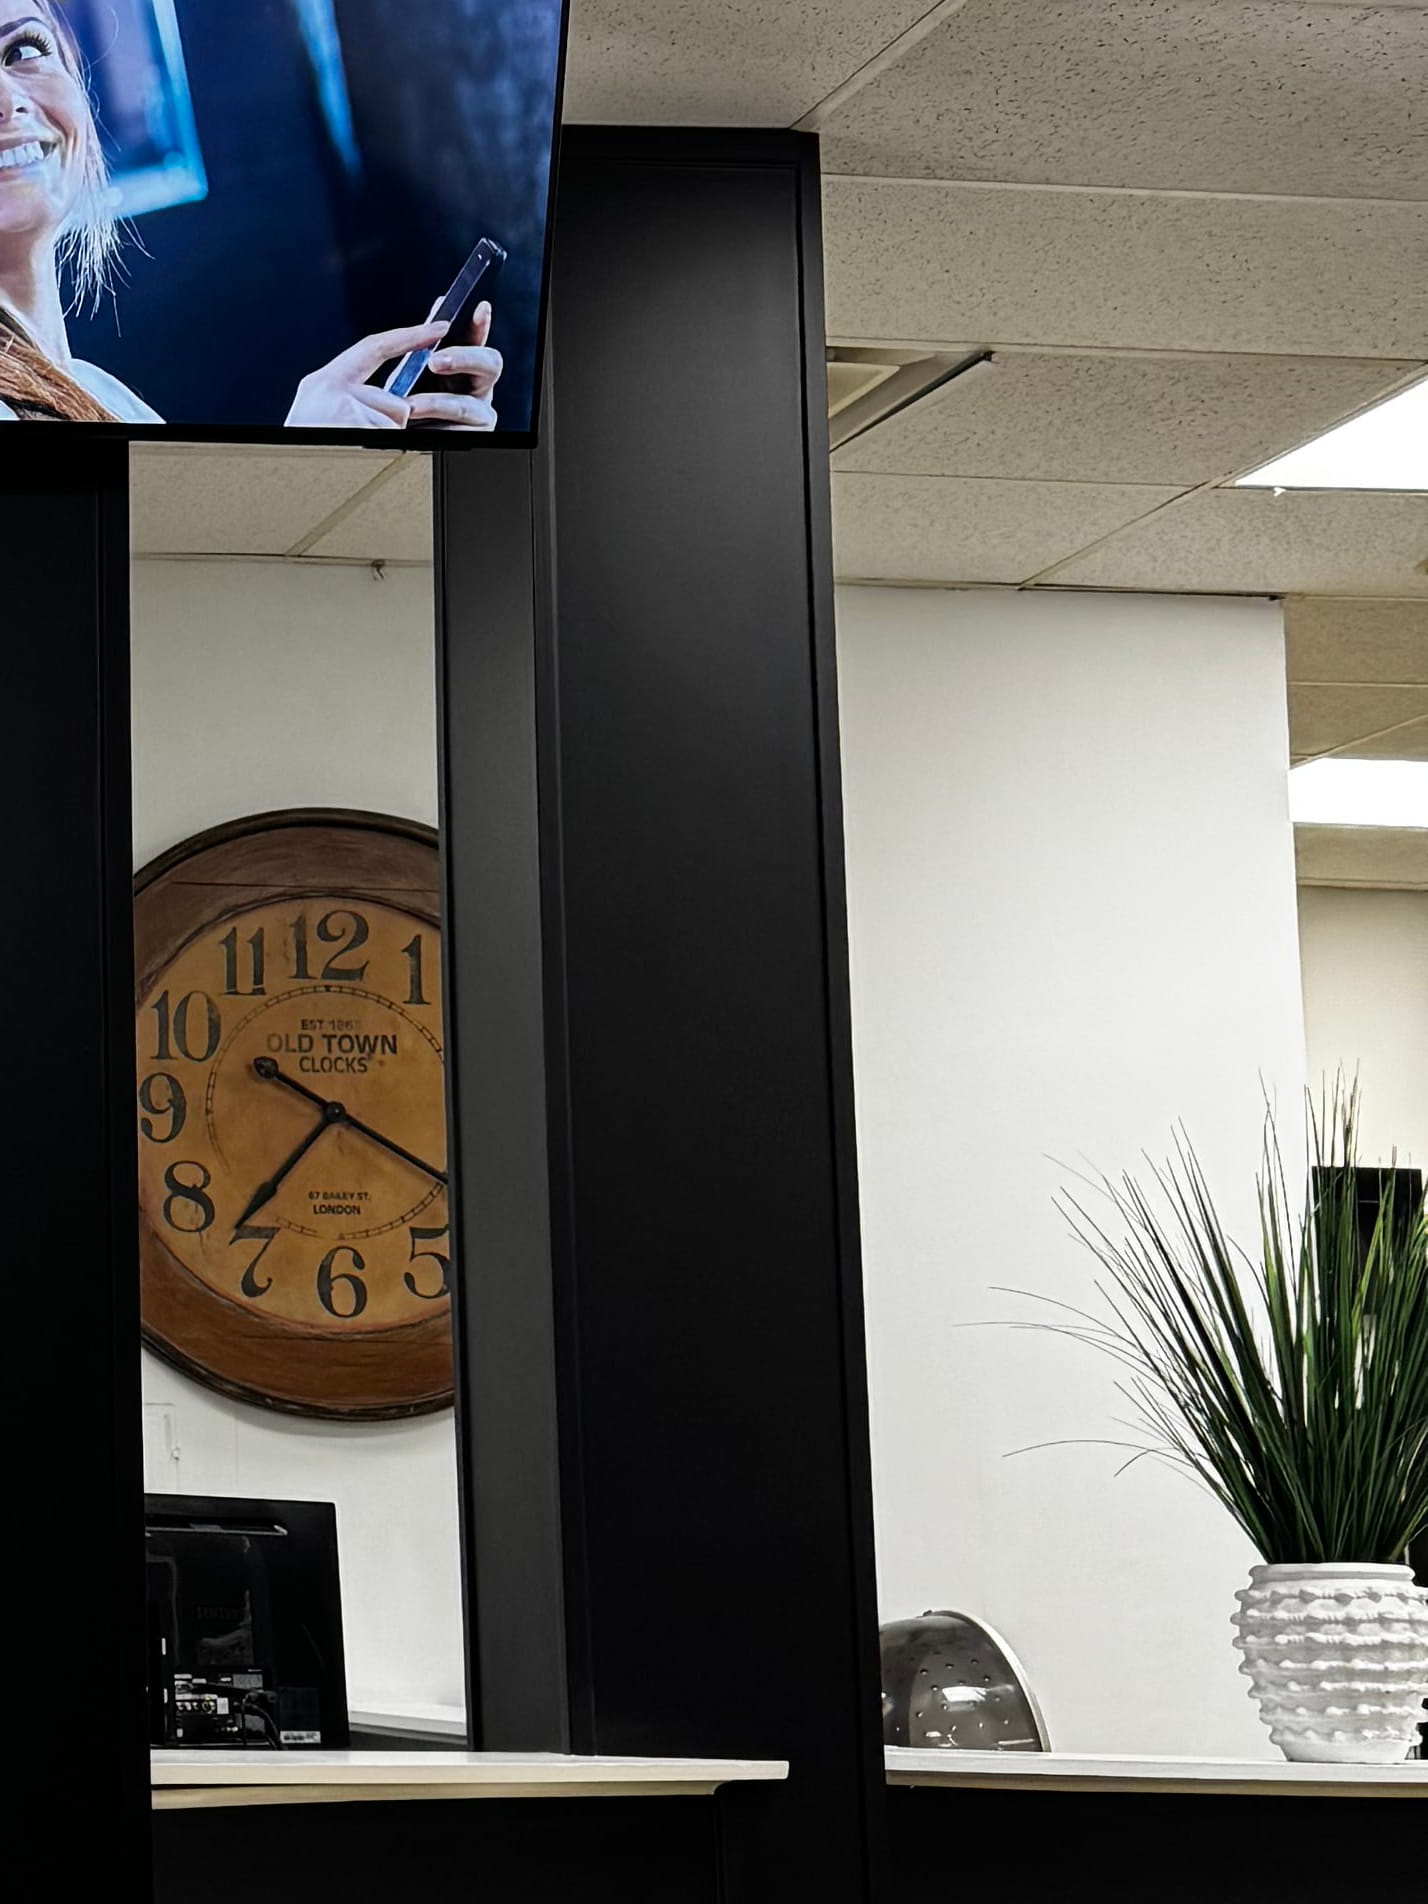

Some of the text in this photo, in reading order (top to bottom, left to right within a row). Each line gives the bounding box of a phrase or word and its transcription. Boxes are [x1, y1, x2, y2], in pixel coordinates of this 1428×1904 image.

[219, 926, 266, 996] 11
[288, 910, 369, 981] 12
[401, 933, 431, 1005] 1
[151, 990, 221, 1062] 10
[267, 1033, 398, 1054] OLD TOWN
[299, 1056, 368, 1073] CLOCKS
[139, 1072, 186, 1143] 9
[163, 1160, 216, 1232] 8
[313, 1204, 361, 1215] LONDON
[228, 1225, 281, 1298] 7
[317, 1246, 367, 1318] 6
[404, 1224, 449, 1299] 5
